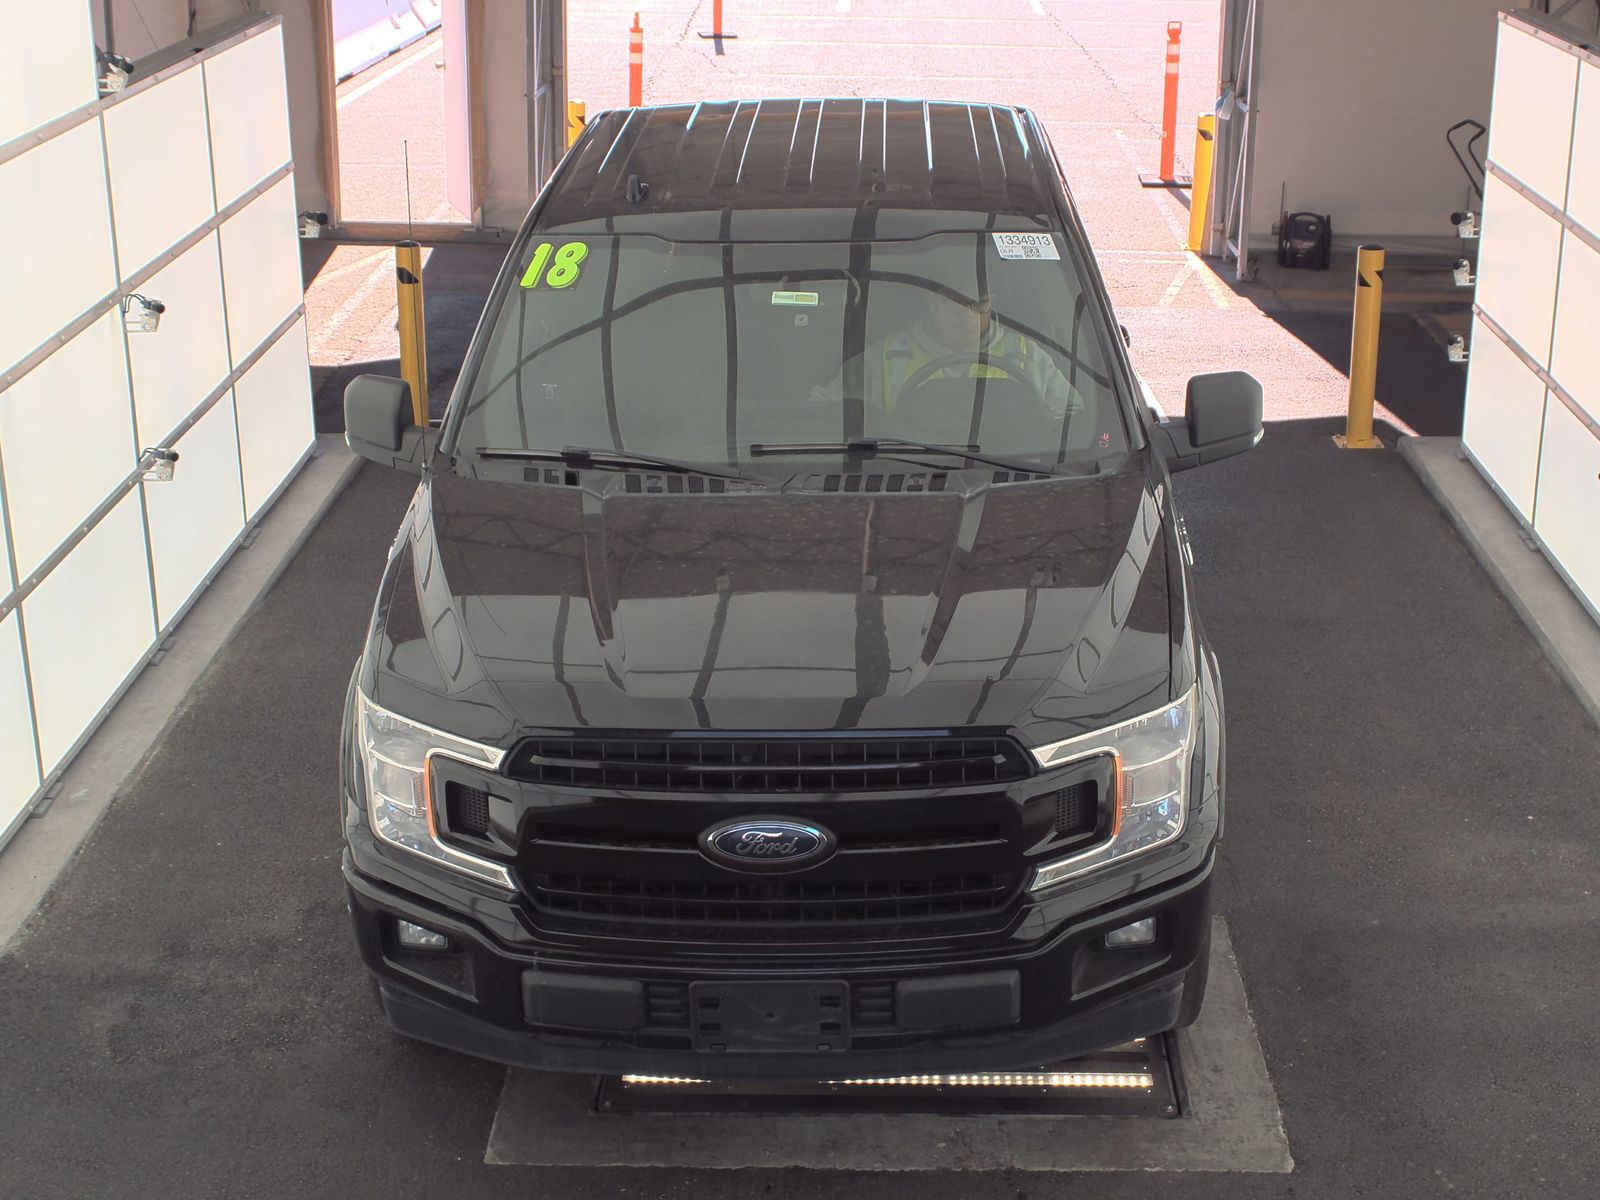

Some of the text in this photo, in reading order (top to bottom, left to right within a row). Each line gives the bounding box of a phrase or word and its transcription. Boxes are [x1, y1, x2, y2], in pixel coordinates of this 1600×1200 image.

[999, 235, 1051, 246] 1334913
[520, 241, 588, 289] 18
[735, 830, 799, 855] Ford
